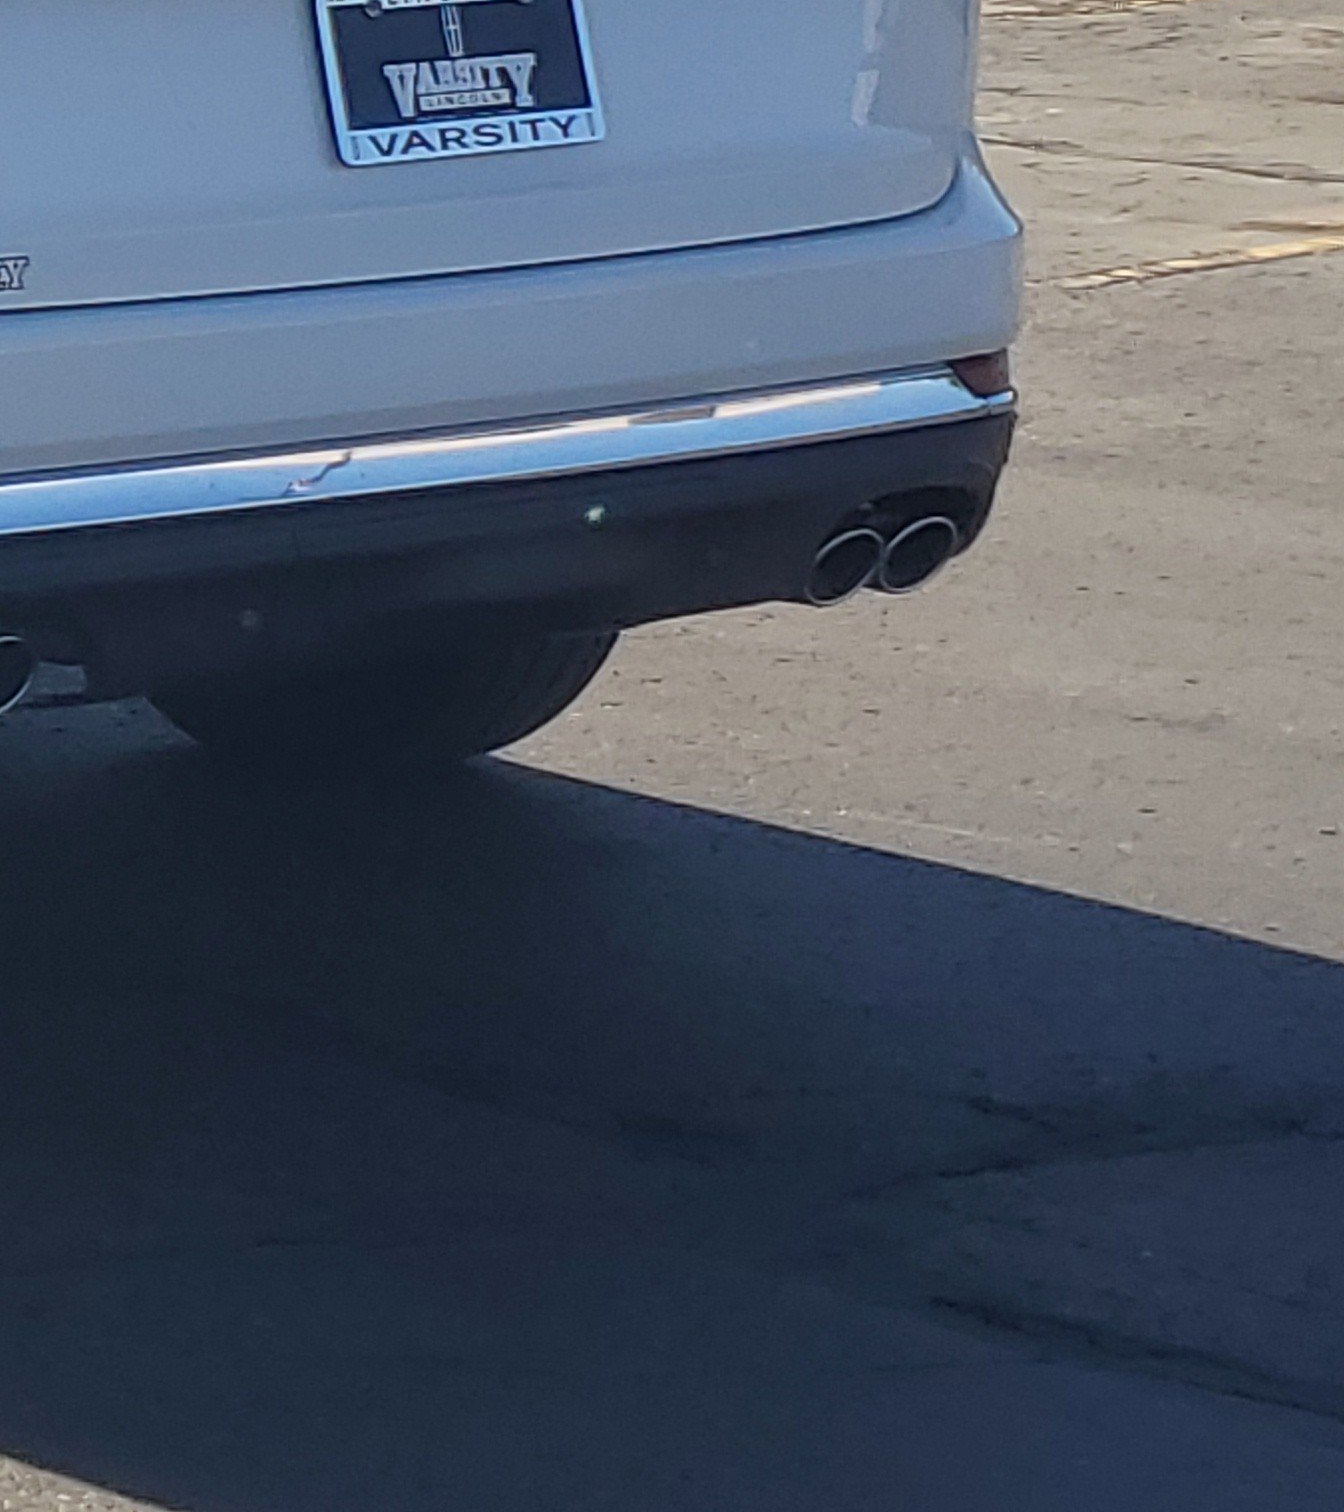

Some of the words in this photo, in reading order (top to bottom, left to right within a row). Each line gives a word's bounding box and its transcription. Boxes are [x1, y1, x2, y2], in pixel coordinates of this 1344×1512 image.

[383, 53, 536, 118] VARSITY
[425, 91, 503, 107] LINCOLN
[368, 114, 577, 157] VARSITY
